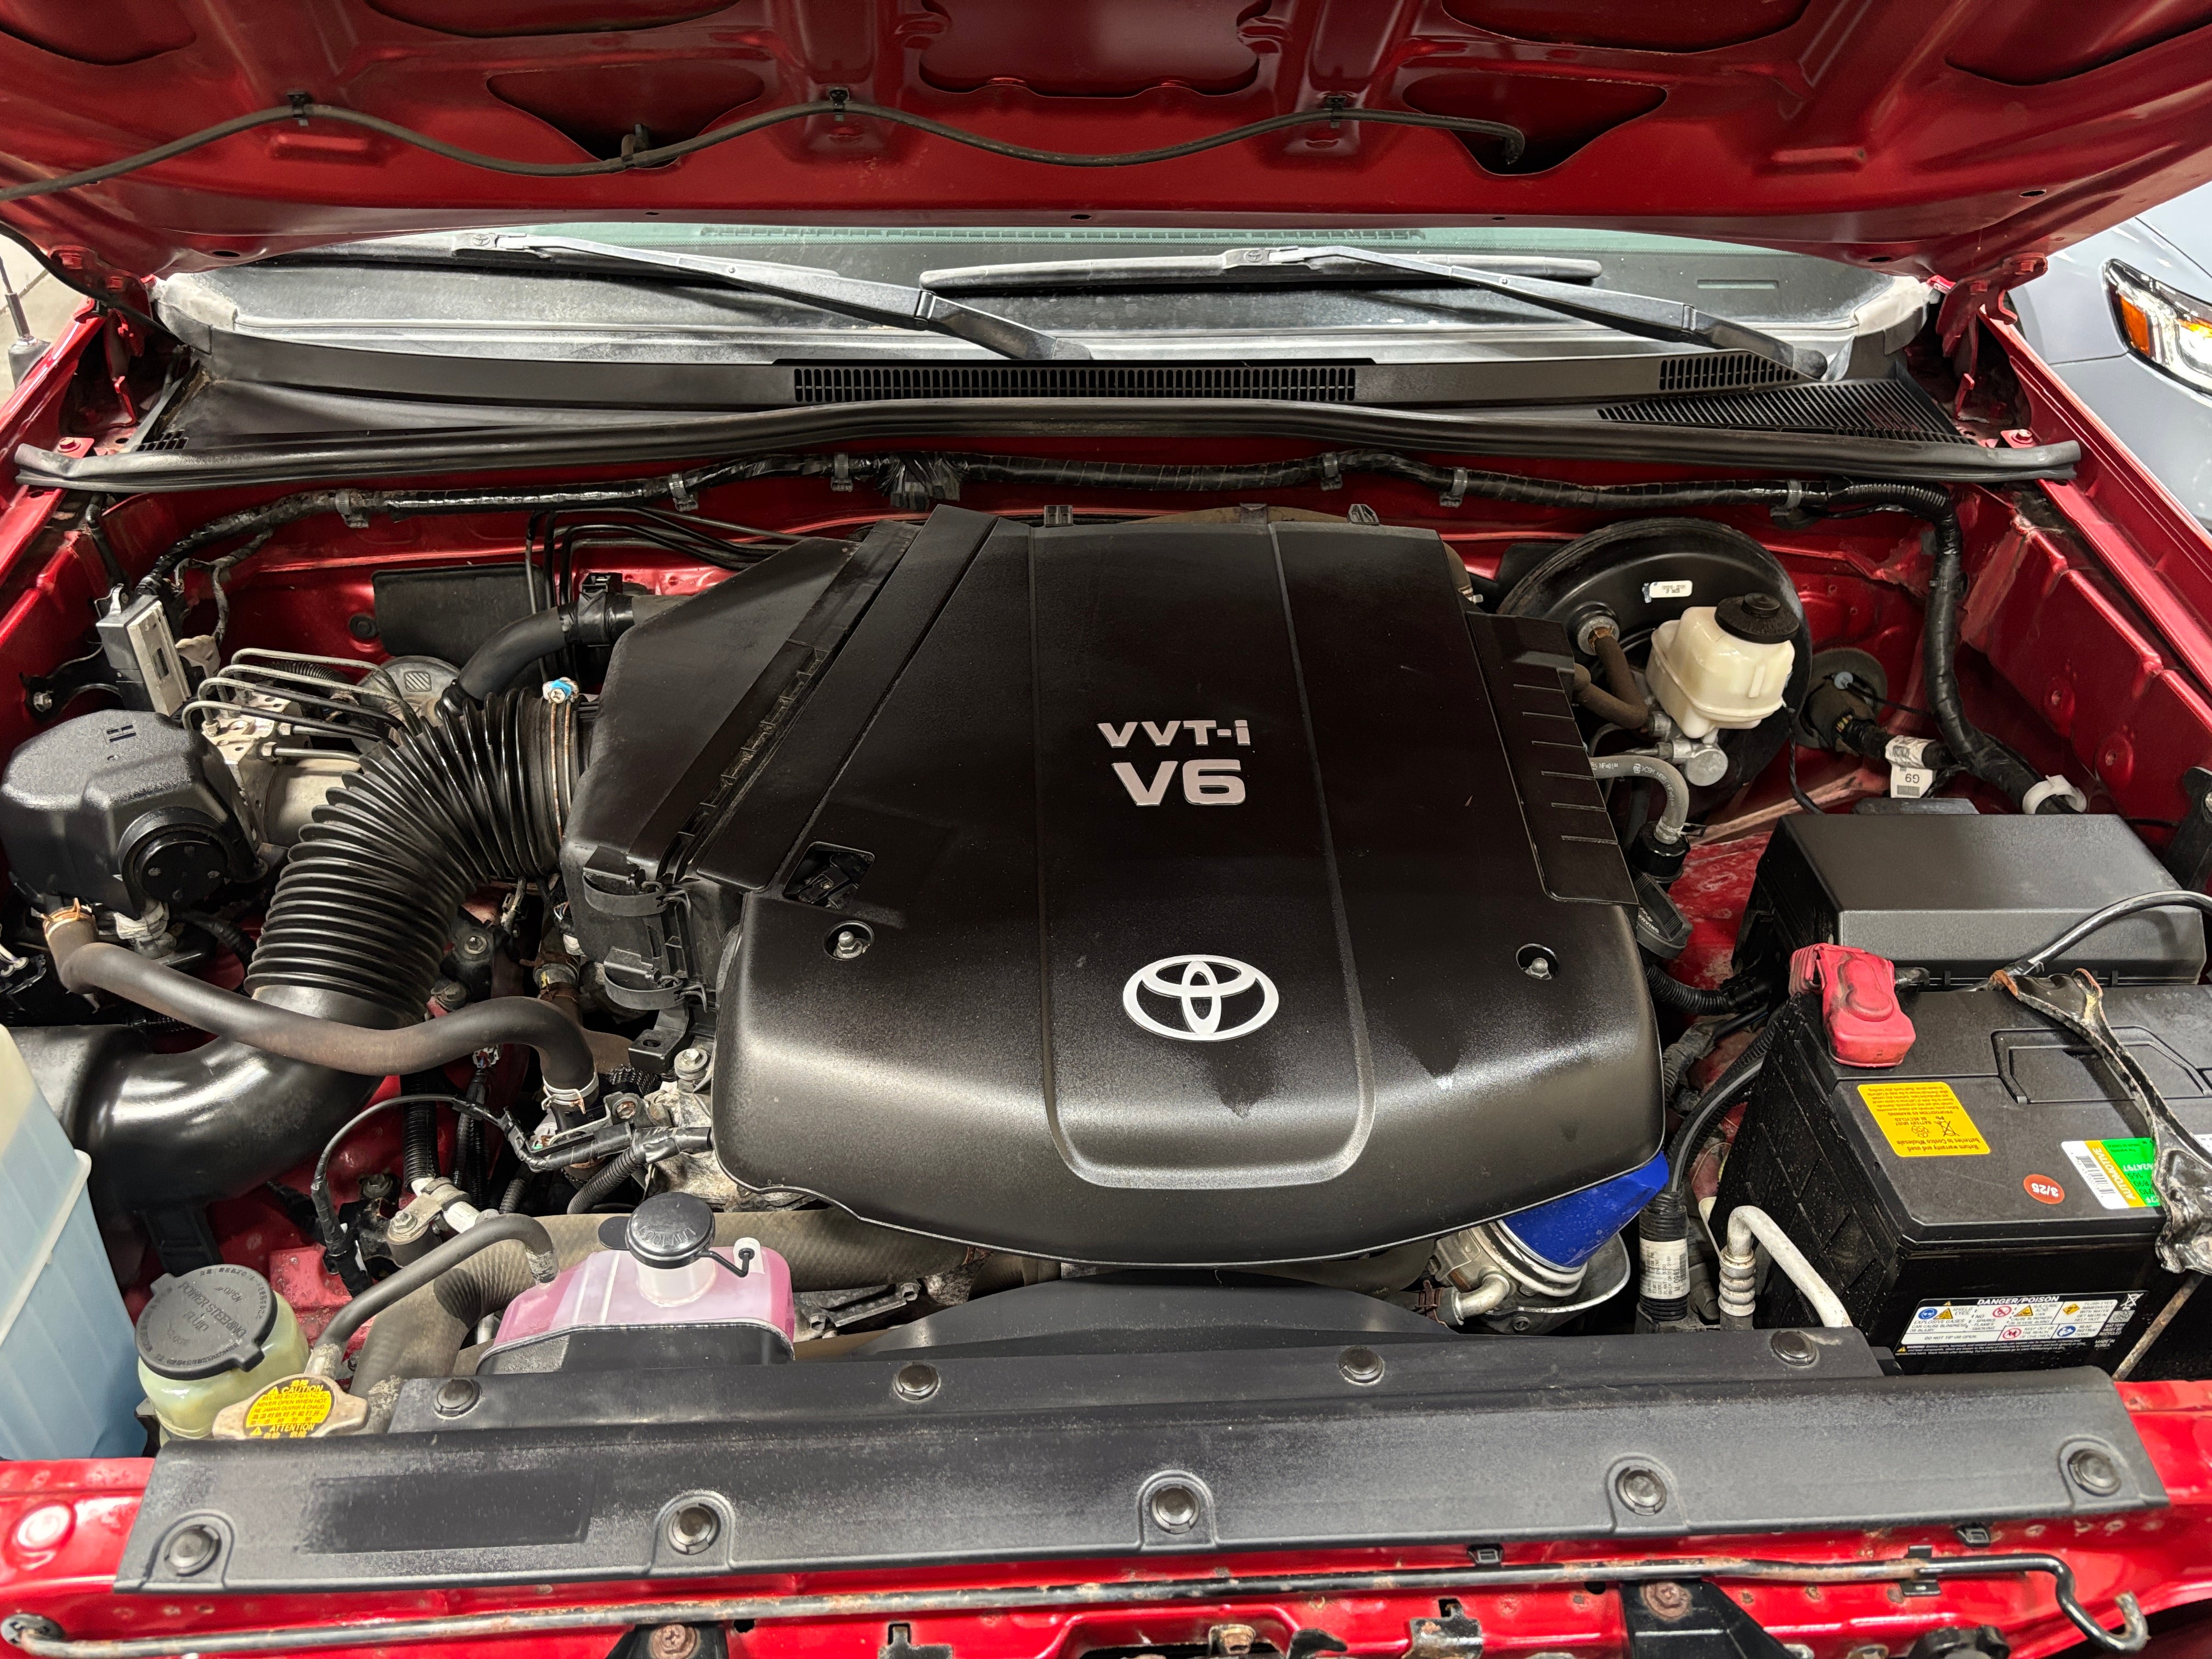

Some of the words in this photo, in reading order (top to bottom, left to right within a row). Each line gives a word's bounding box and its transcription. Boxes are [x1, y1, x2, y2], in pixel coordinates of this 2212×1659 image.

[1097, 720, 1251, 748] VVT-i
[1111, 759, 1246, 806] V6
[1905, 773, 1920, 784] G9
[2092, 1147, 2136, 1200] AUTOMOTIVE
[2031, 1182, 2059, 1198] 3/25
[639, 1225, 696, 1248] COOLANT
[223, 1286, 242, 1303] OPEN
[1977, 1295, 2059, 1306] DANGER/POISON
[178, 1280, 210, 1308] POWER
[205, 1302, 247, 1339] STEERING
[183, 1310, 209, 1333] FLUID
[281, 1385, 324, 1394] CAUTION
[269, 1423, 315, 1432] ATTENTION
